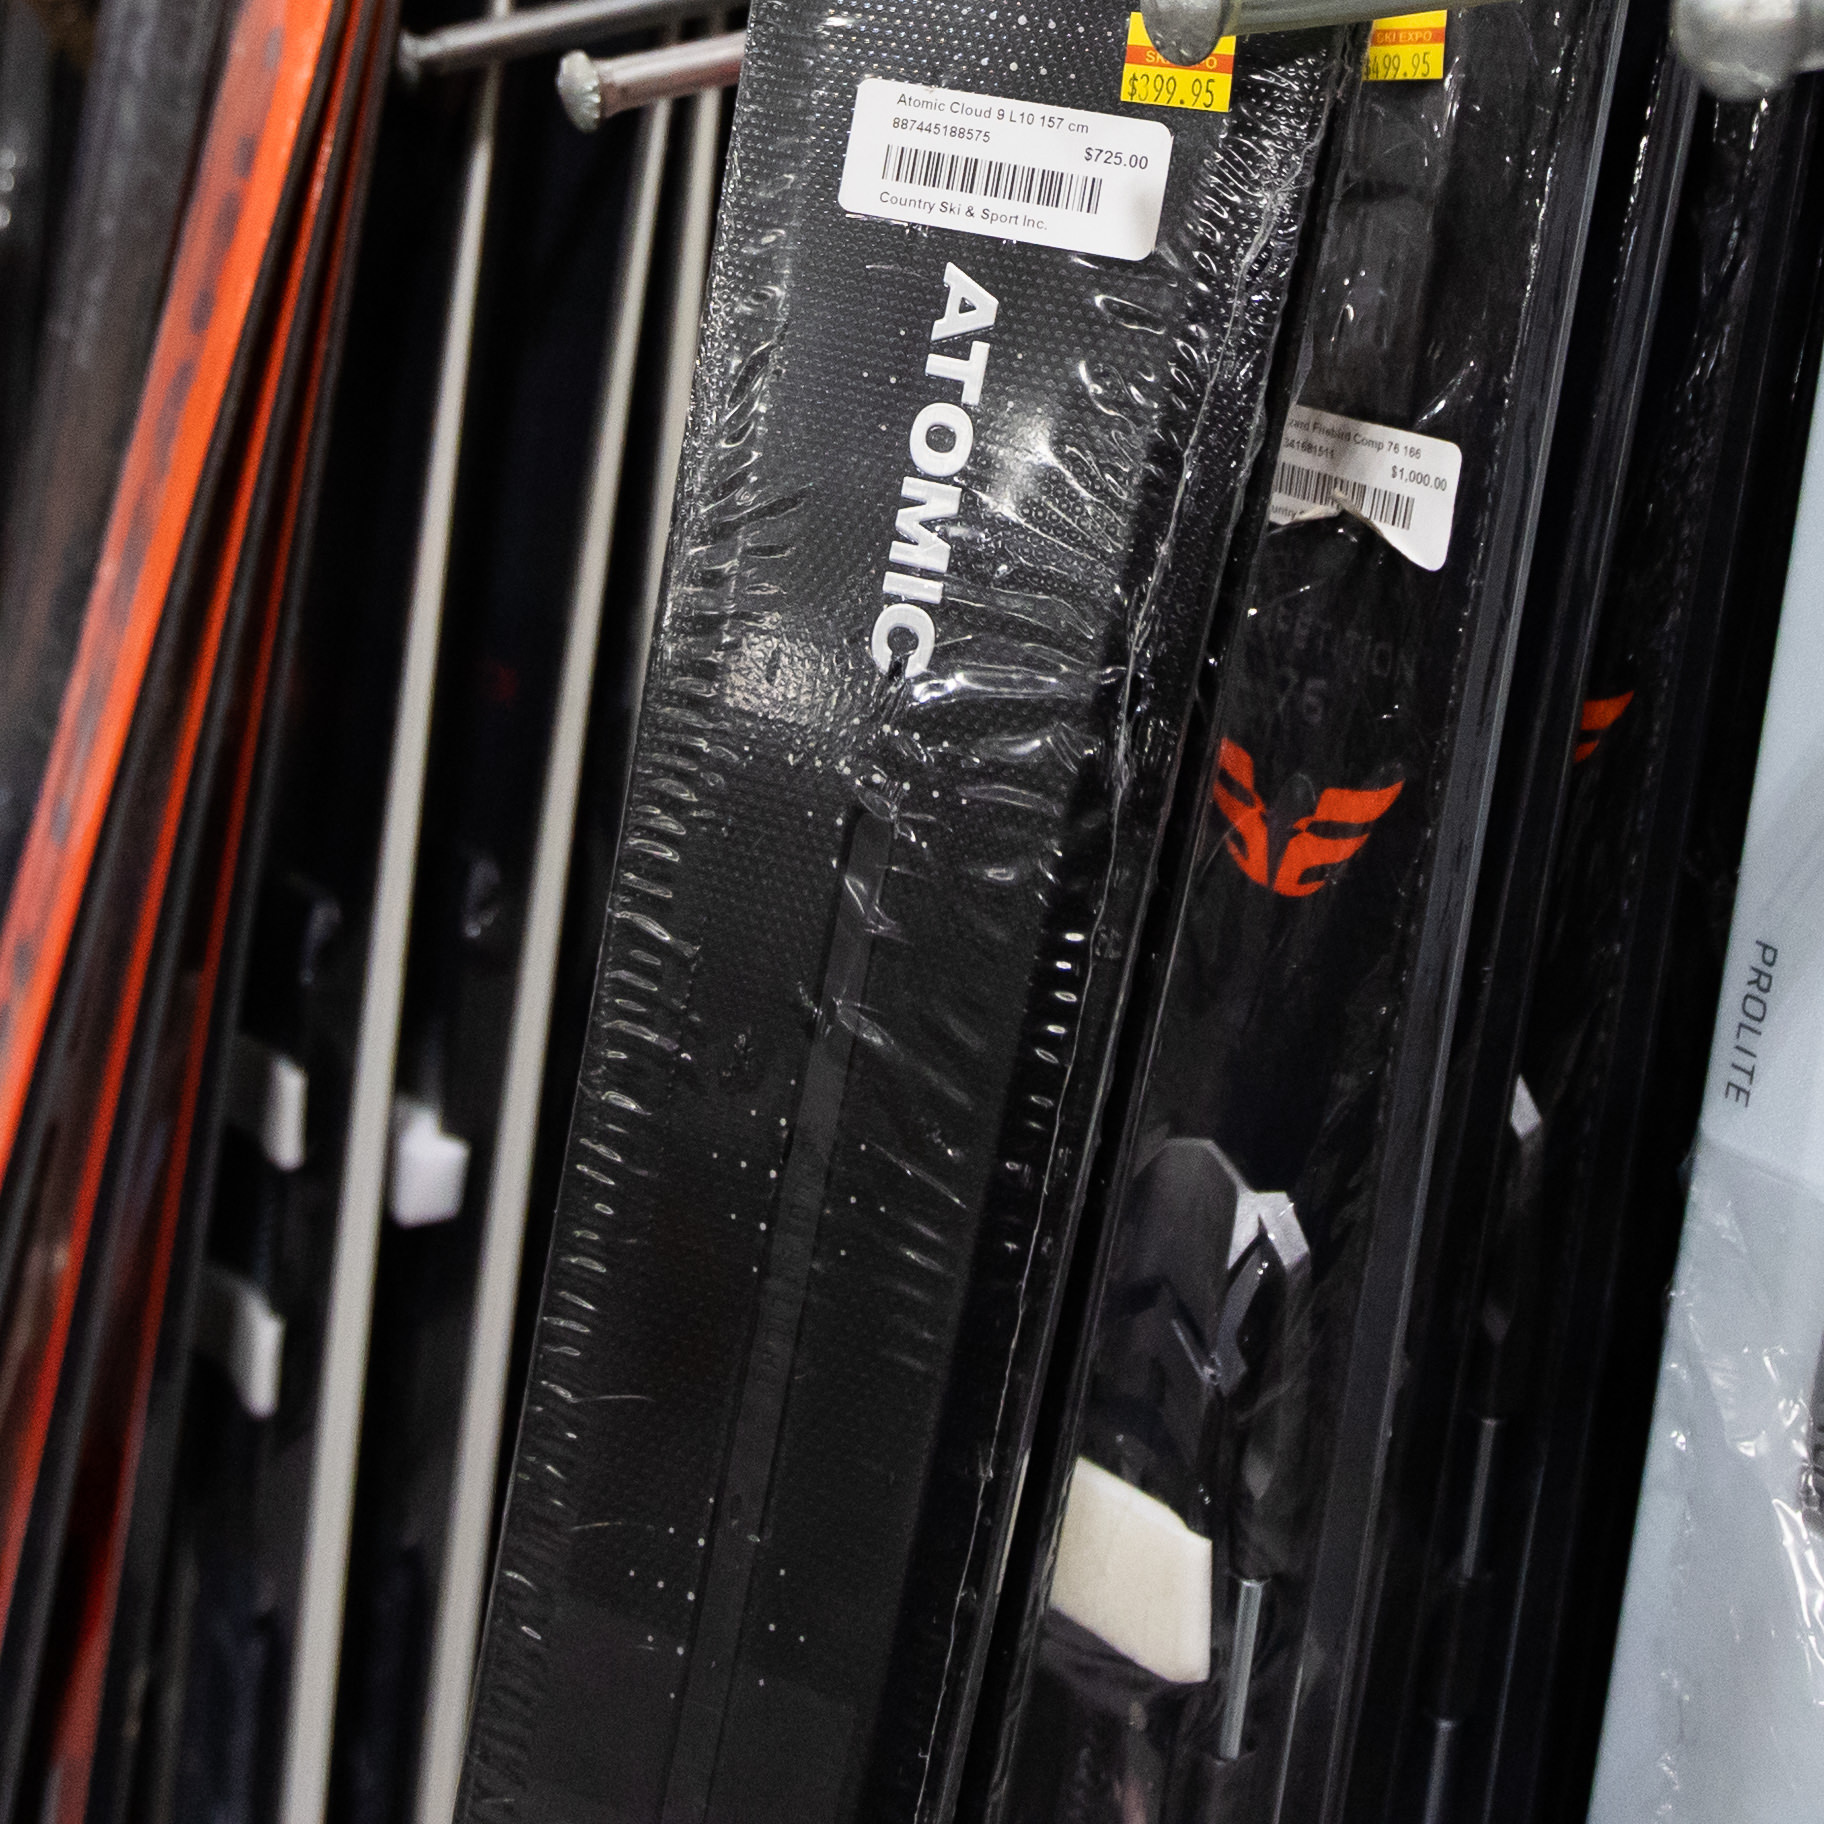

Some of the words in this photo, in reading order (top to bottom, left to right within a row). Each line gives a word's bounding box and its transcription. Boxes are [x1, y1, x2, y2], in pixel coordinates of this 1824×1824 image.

[1377, 31, 1396, 44] SKI
[1399, 30, 1433, 43] EXPO
[1127, 72, 1215, 108] $399.95
[896, 93, 945, 113] Atomic
[949, 101, 992, 120] Cloud
[996, 108, 1005, 121] 9
[1009, 110, 1034, 125] L10
[1039, 115, 1065, 130] 157
[1068, 122, 1089, 134] cm
[892, 116, 991, 143] 887445188575
[1084, 146, 1149, 171] $725.00
[879, 191, 935, 213] Country
[939, 201, 961, 216] Ski
[965, 205, 975, 218] &
[981, 208, 1019, 226] Sport
[1023, 215, 1048, 230] Inc.
[1353, 432, 1384, 453] Comp
[872, 261, 999, 678] ATOMIC
[1391, 465, 1447, 492] $1,000.00
[1724, 940, 1779, 1109] PROLITE
